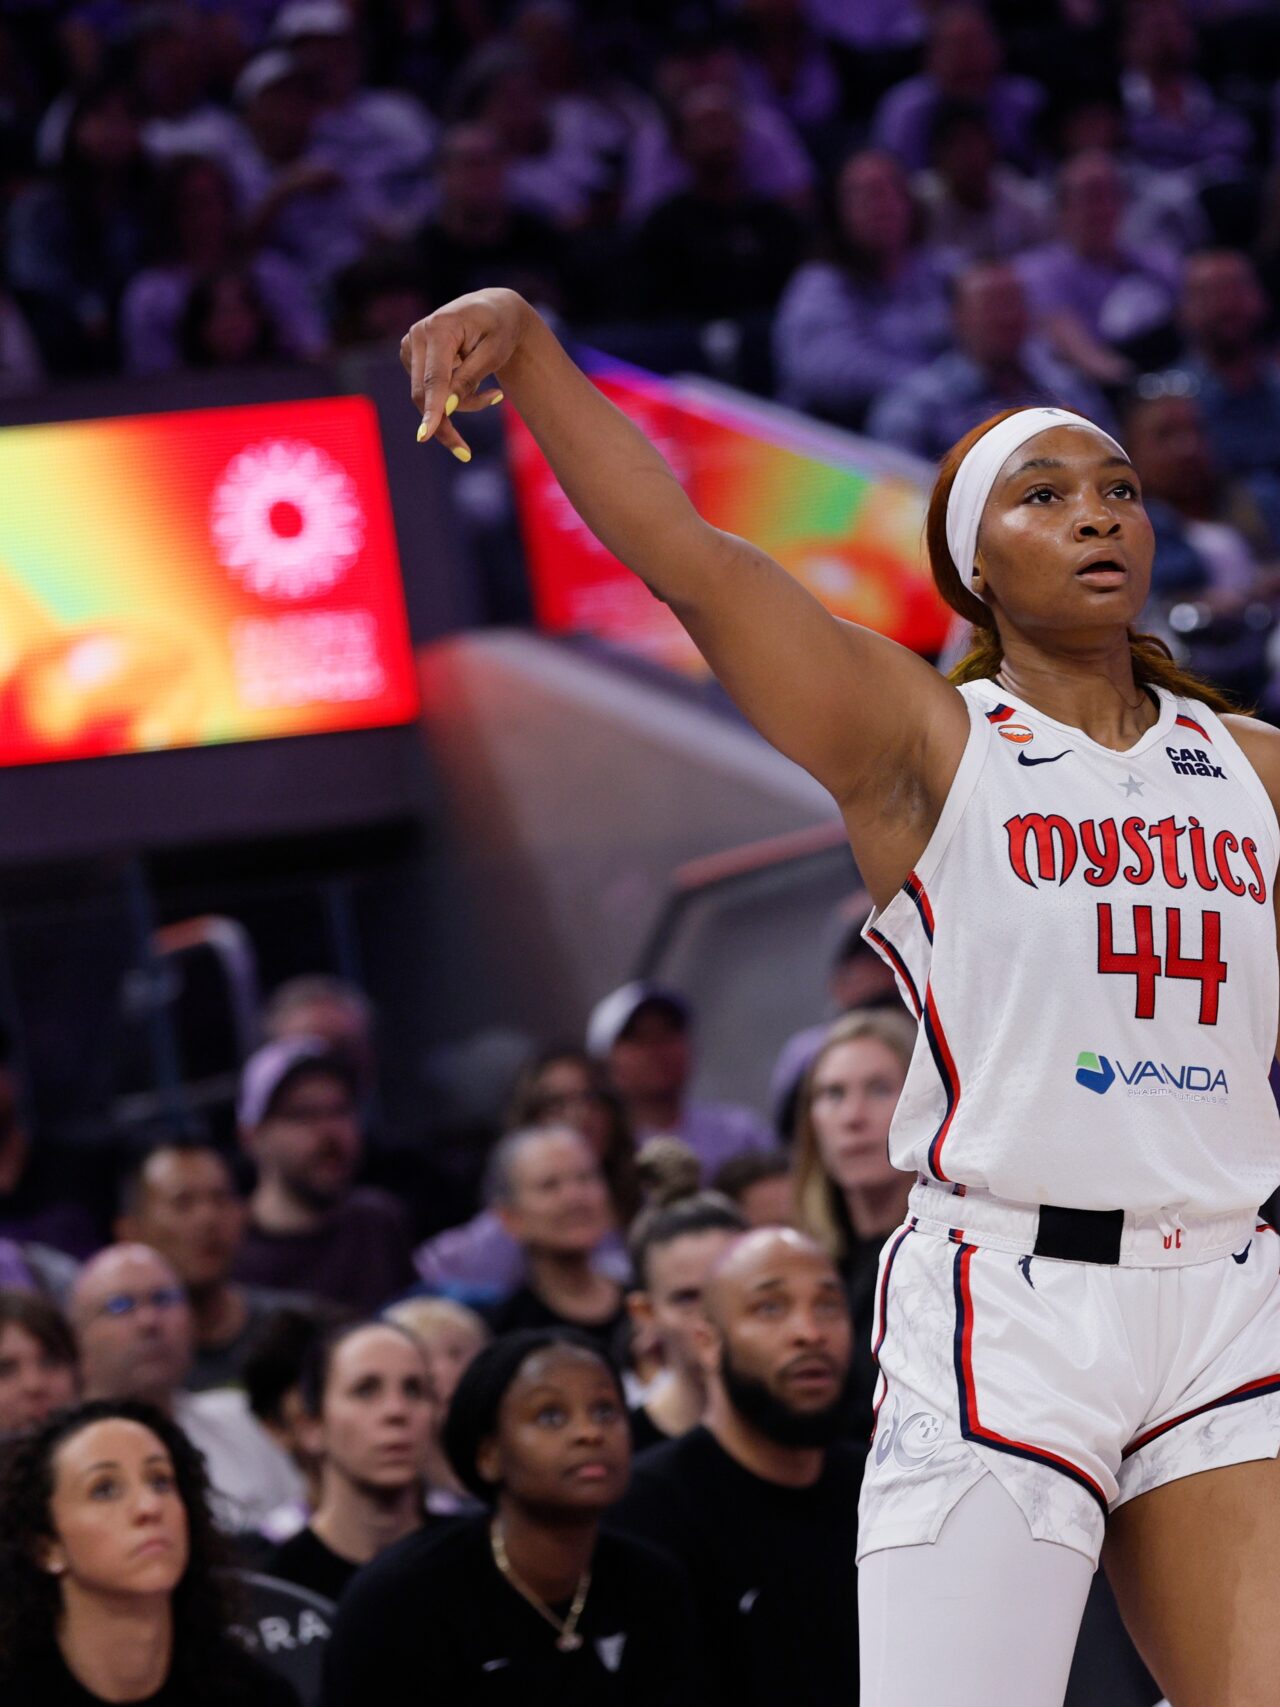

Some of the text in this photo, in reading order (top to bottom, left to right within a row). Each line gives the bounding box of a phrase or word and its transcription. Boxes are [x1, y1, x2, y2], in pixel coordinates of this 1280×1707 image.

[1165, 746, 1211, 764] CAR
[1171, 761, 1228, 780] max
[1097, 902, 1228, 1026] 44
[1115, 1060, 1229, 1095] VANDA
